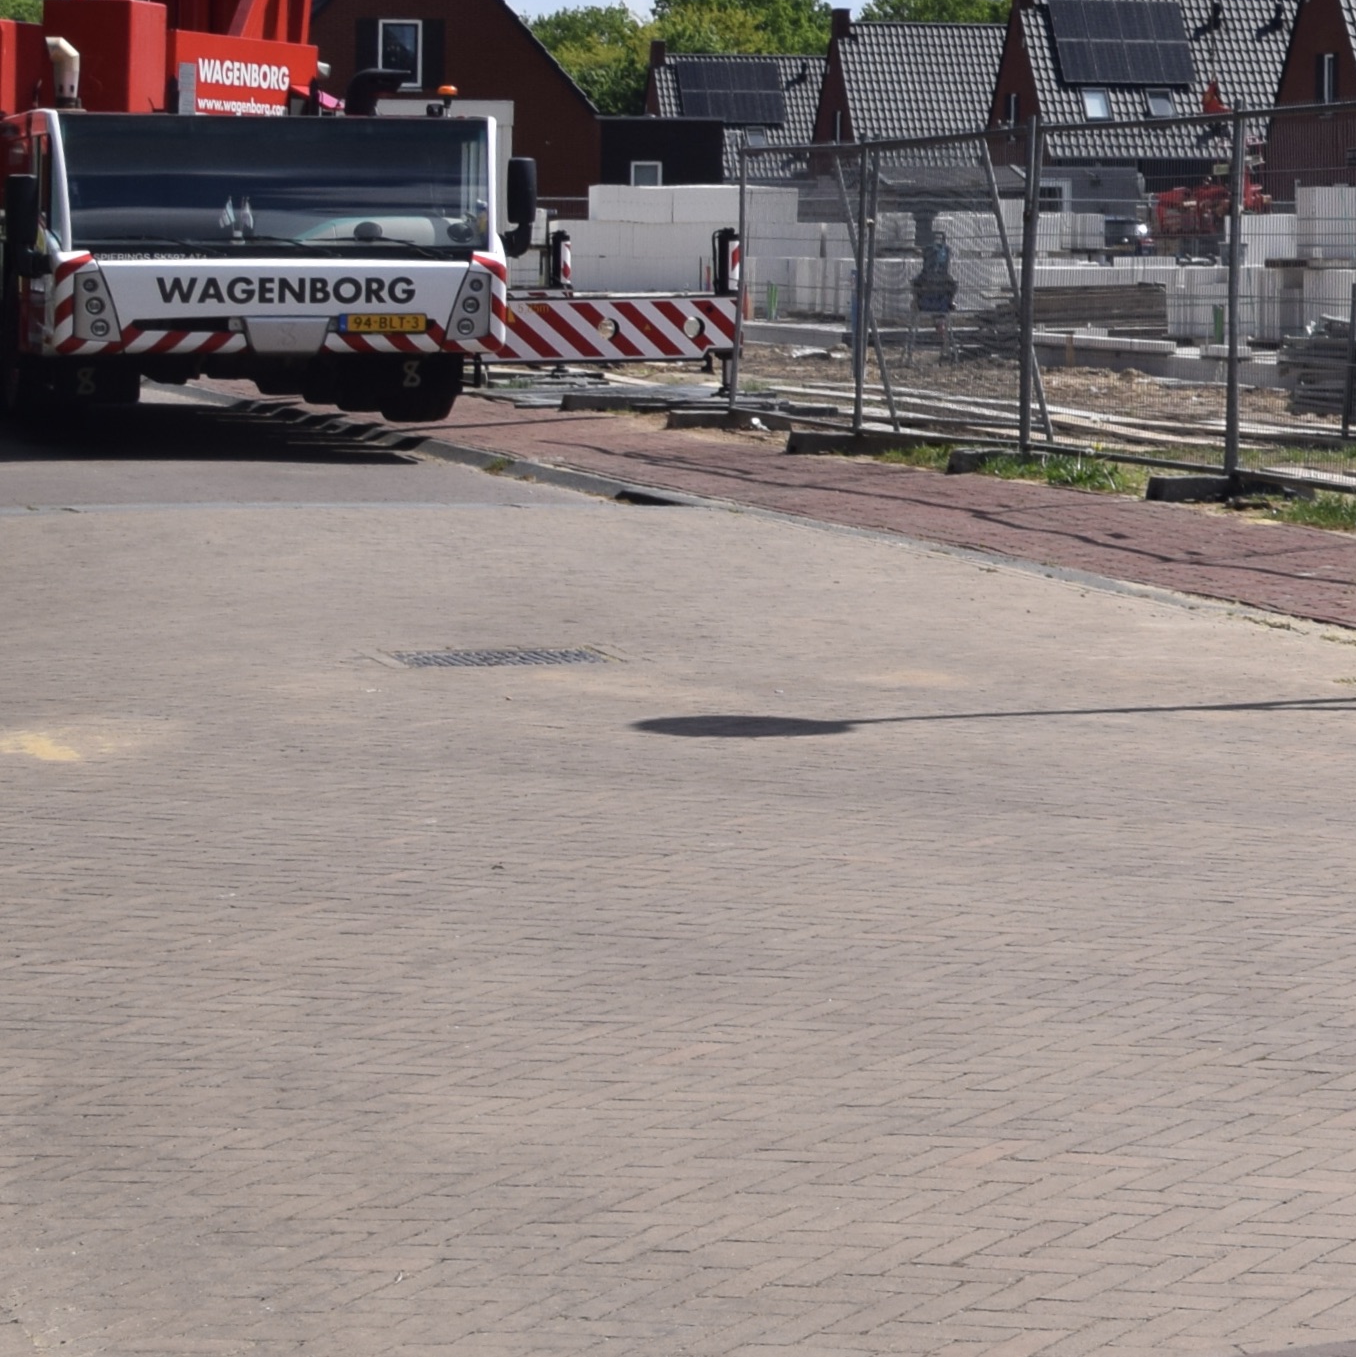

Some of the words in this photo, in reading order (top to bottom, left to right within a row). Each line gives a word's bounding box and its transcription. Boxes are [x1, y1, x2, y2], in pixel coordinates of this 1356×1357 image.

[198, 57, 290, 91] WAGENBORG
[156, 277, 416, 304] WAGENBORG
[353, 316, 420, 330] 94-BLT-3
